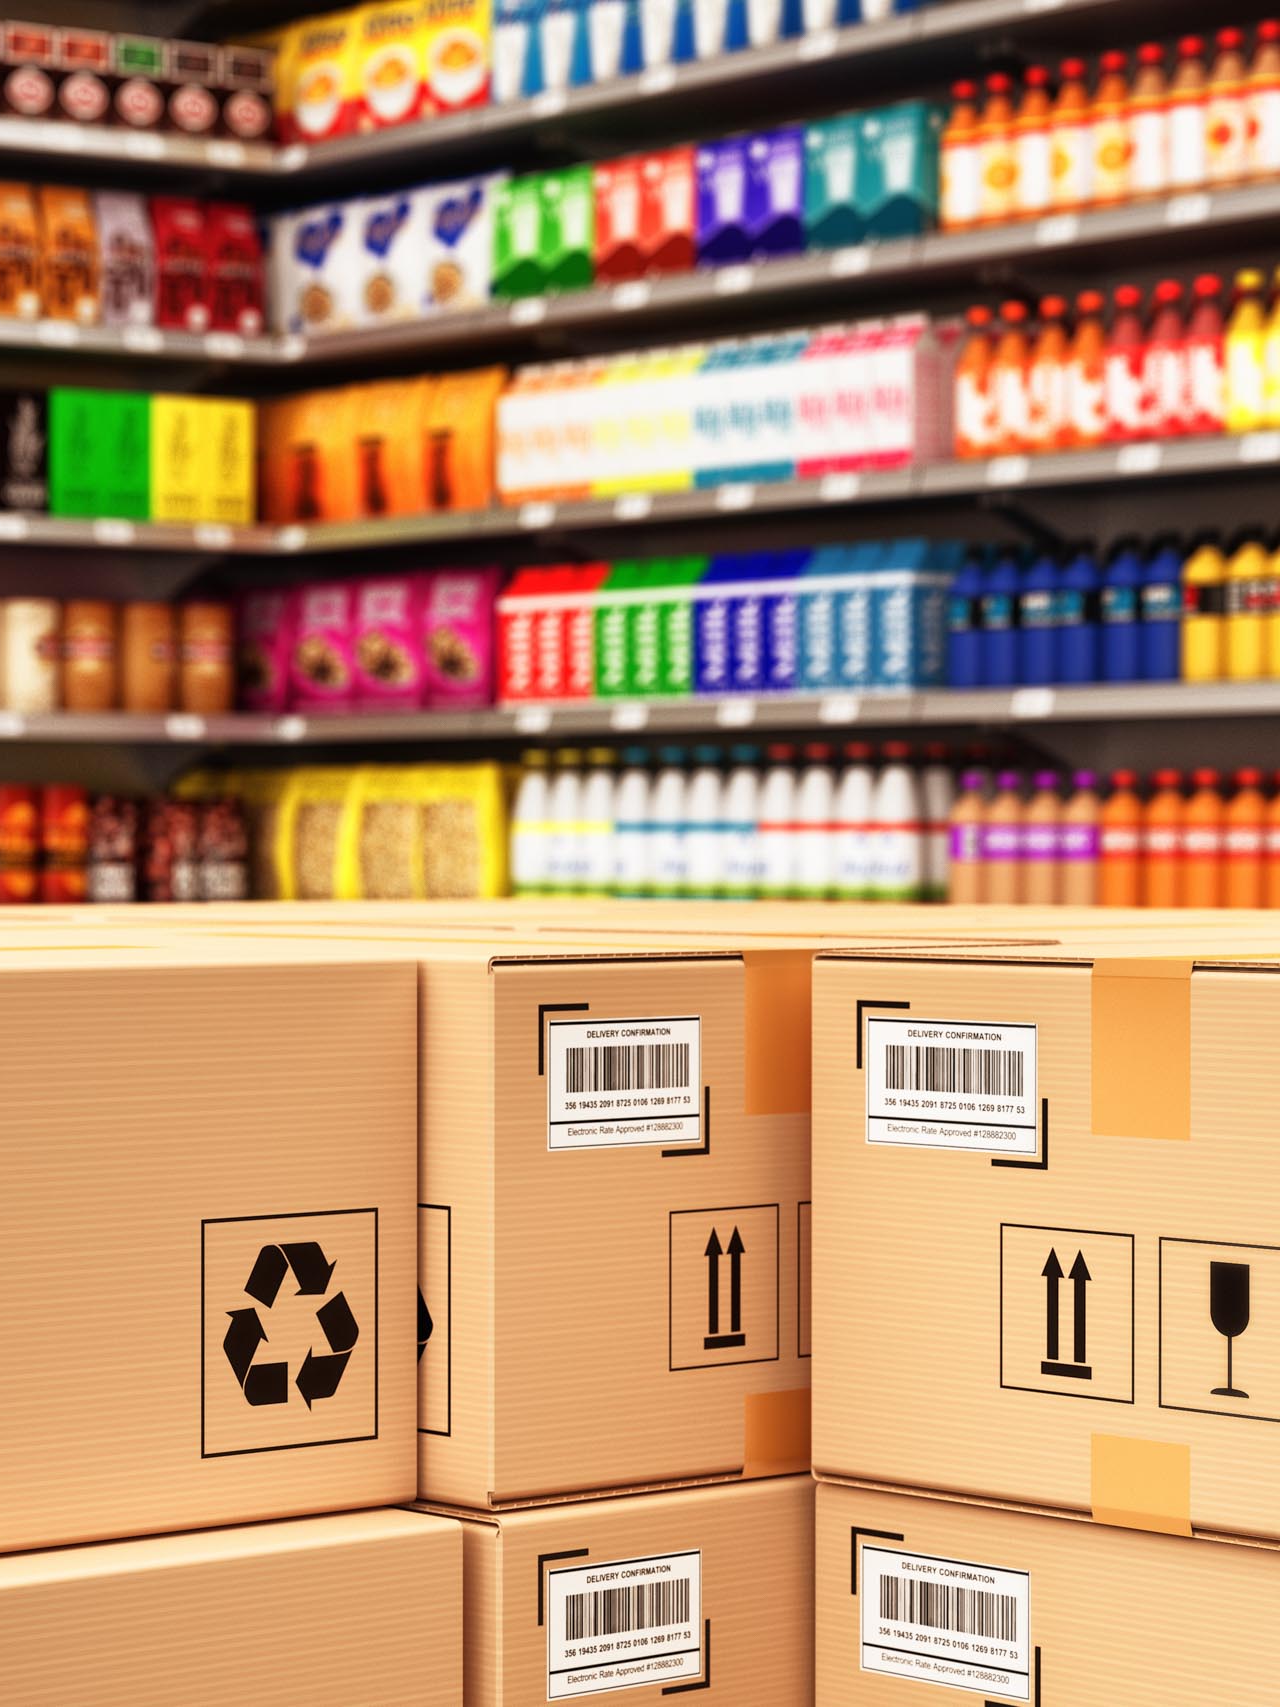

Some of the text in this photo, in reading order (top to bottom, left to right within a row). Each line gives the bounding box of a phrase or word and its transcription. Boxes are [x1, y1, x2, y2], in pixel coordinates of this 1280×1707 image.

[587, 1028, 671, 1038] DELIVERY CONFIRMATION
[908, 1030, 1002, 1041] DELIVERY CONFIRMATION
[565, 1101, 576, 1110] 356
[579, 1101, 597, 1109] 19435
[599, 1100, 614, 1108] 2091
[616, 1099, 631, 1107] 8725
[633, 1098, 648, 1106] 0106
[885, 1098, 896, 1106] 356
[899, 1099, 919, 1107] 19435
[921, 1100, 937, 1108] 2091
[940, 1101, 957, 1109] 8725
[979, 1104, 994, 1112] 1269
[997, 1105, 1013, 1113] 8177
[887, 1124, 1016, 1140] Electronic Rate Approved #128882300
[587, 1565, 671, 1584] DELIVERY CONFIRMATION
[902, 1562, 995, 1584] DELIVERY CONFIRMATION
[565, 1649, 576, 1657] 356
[579, 1646, 597, 1655] 19435
[599, 1643, 614, 1652] 2091
[616, 1641, 631, 1649] 8725
[633, 1638, 648, 1647] 0106
[667, 1632, 681, 1642] 8177
[683, 1631, 691, 1639] 53
[879, 1627, 1018, 1659] 356 19435 2091 8725 0106 1269 8177 53
